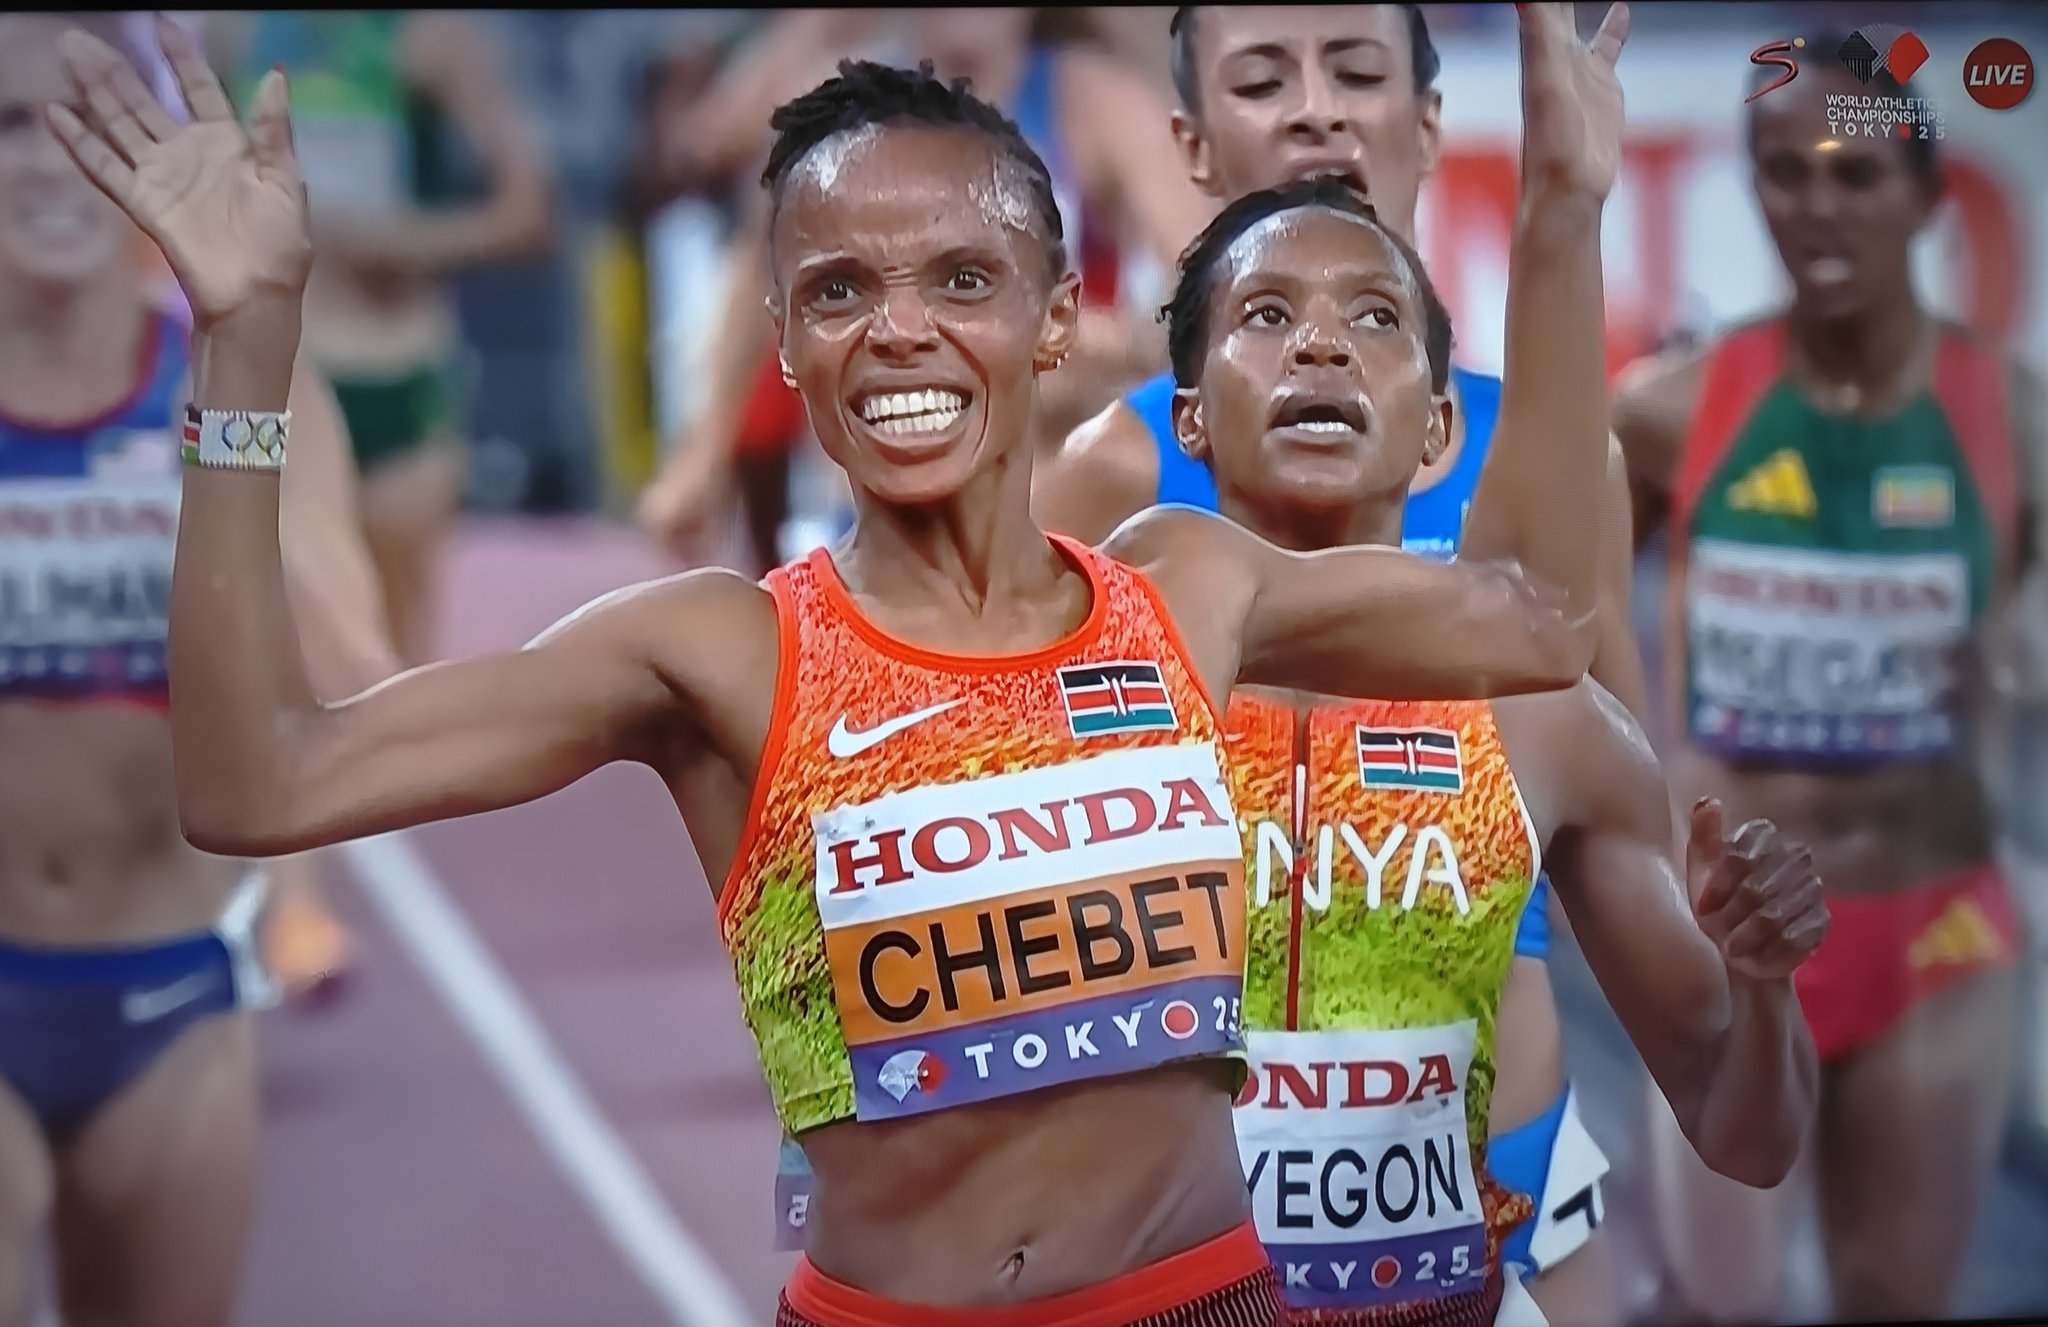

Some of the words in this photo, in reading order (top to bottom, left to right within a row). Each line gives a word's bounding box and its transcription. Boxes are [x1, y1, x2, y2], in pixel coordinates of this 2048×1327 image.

[828, 777, 1229, 895] HONDA
[1240, 821, 1470, 916] NYA
[859, 872, 1228, 1023] CHEBET
[1414, 1246, 1471, 1281] 25
